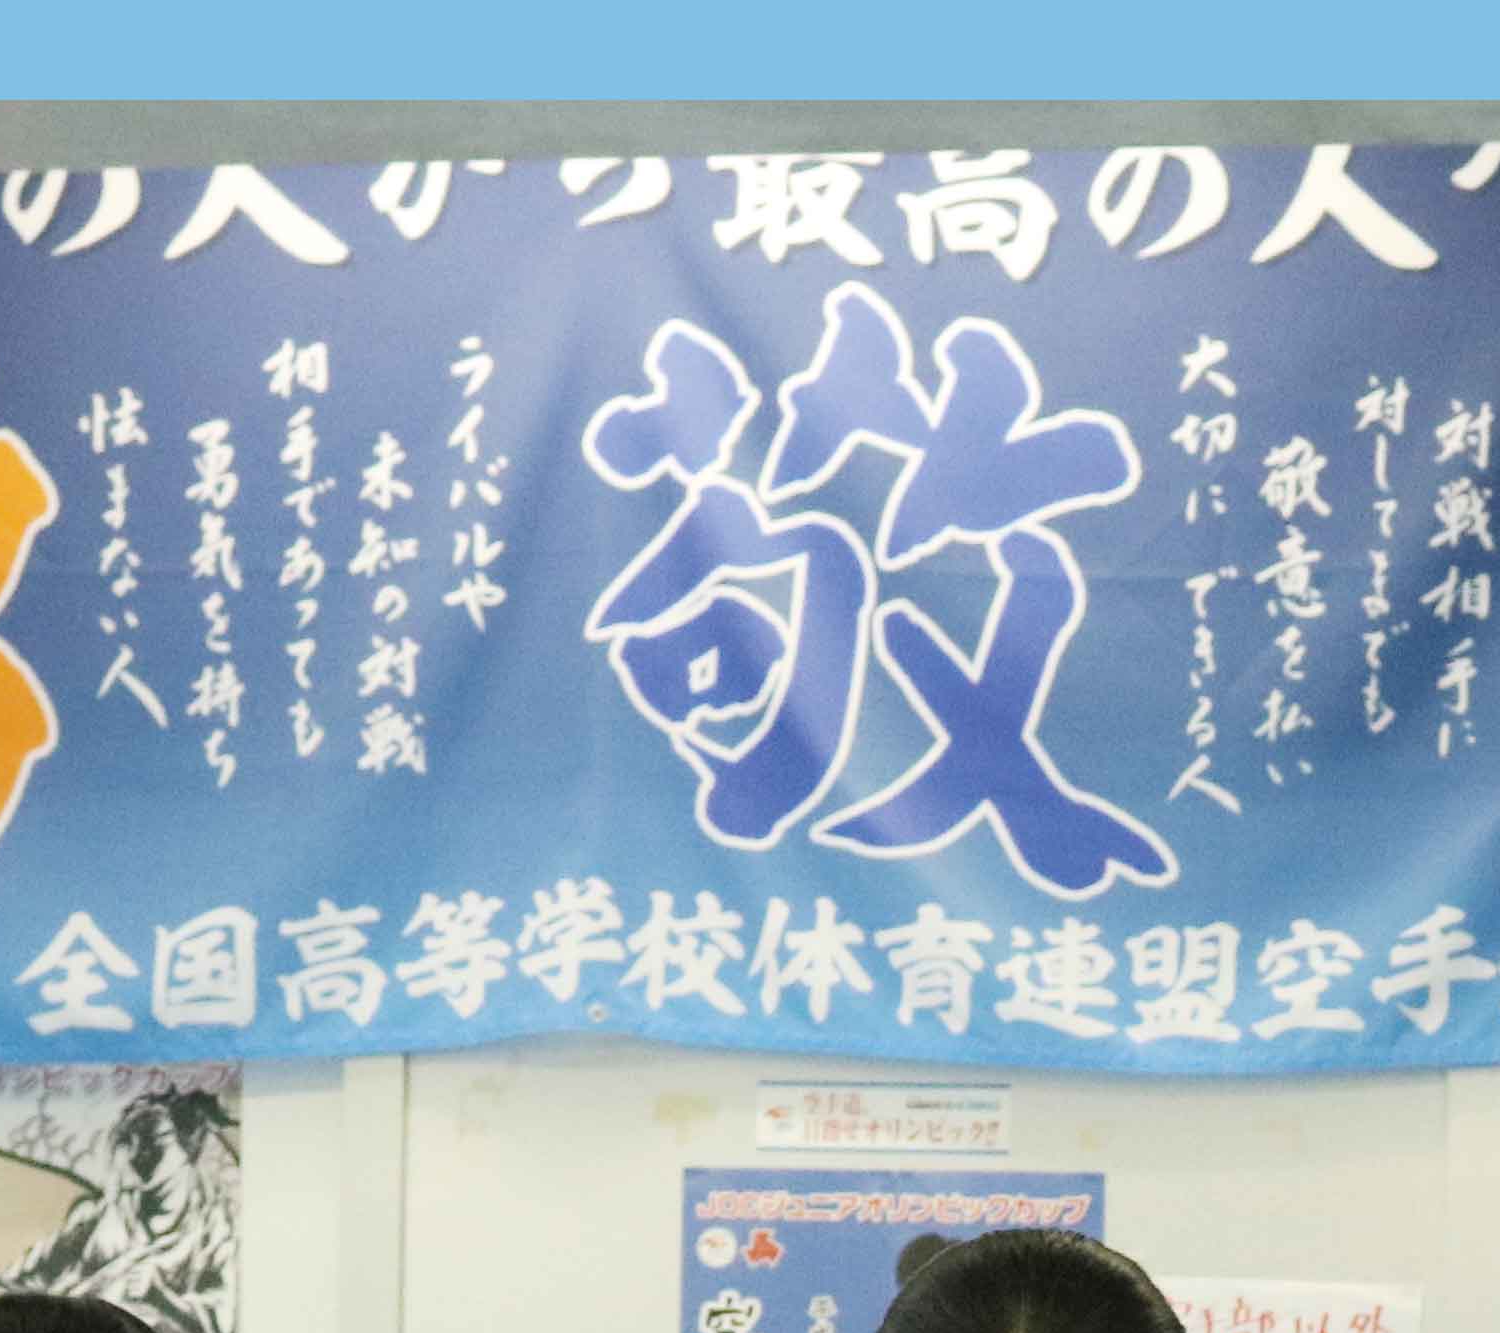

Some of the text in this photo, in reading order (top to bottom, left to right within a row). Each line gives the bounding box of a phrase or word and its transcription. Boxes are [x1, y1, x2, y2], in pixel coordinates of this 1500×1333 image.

[77, 388, 169, 729] 怯まない人
[184, 418, 248, 790] 勇気を持ち
[261, 337, 341, 760] 相手であっても
[348, 431, 430, 776] 未知の対戦
[441, 336, 509, 633] ライバルや
[582, 280, 1180, 901] 敬
[1253, 436, 1333, 787] 敬意を払い
[1418, 399, 1495, 759] 対戦相手に
